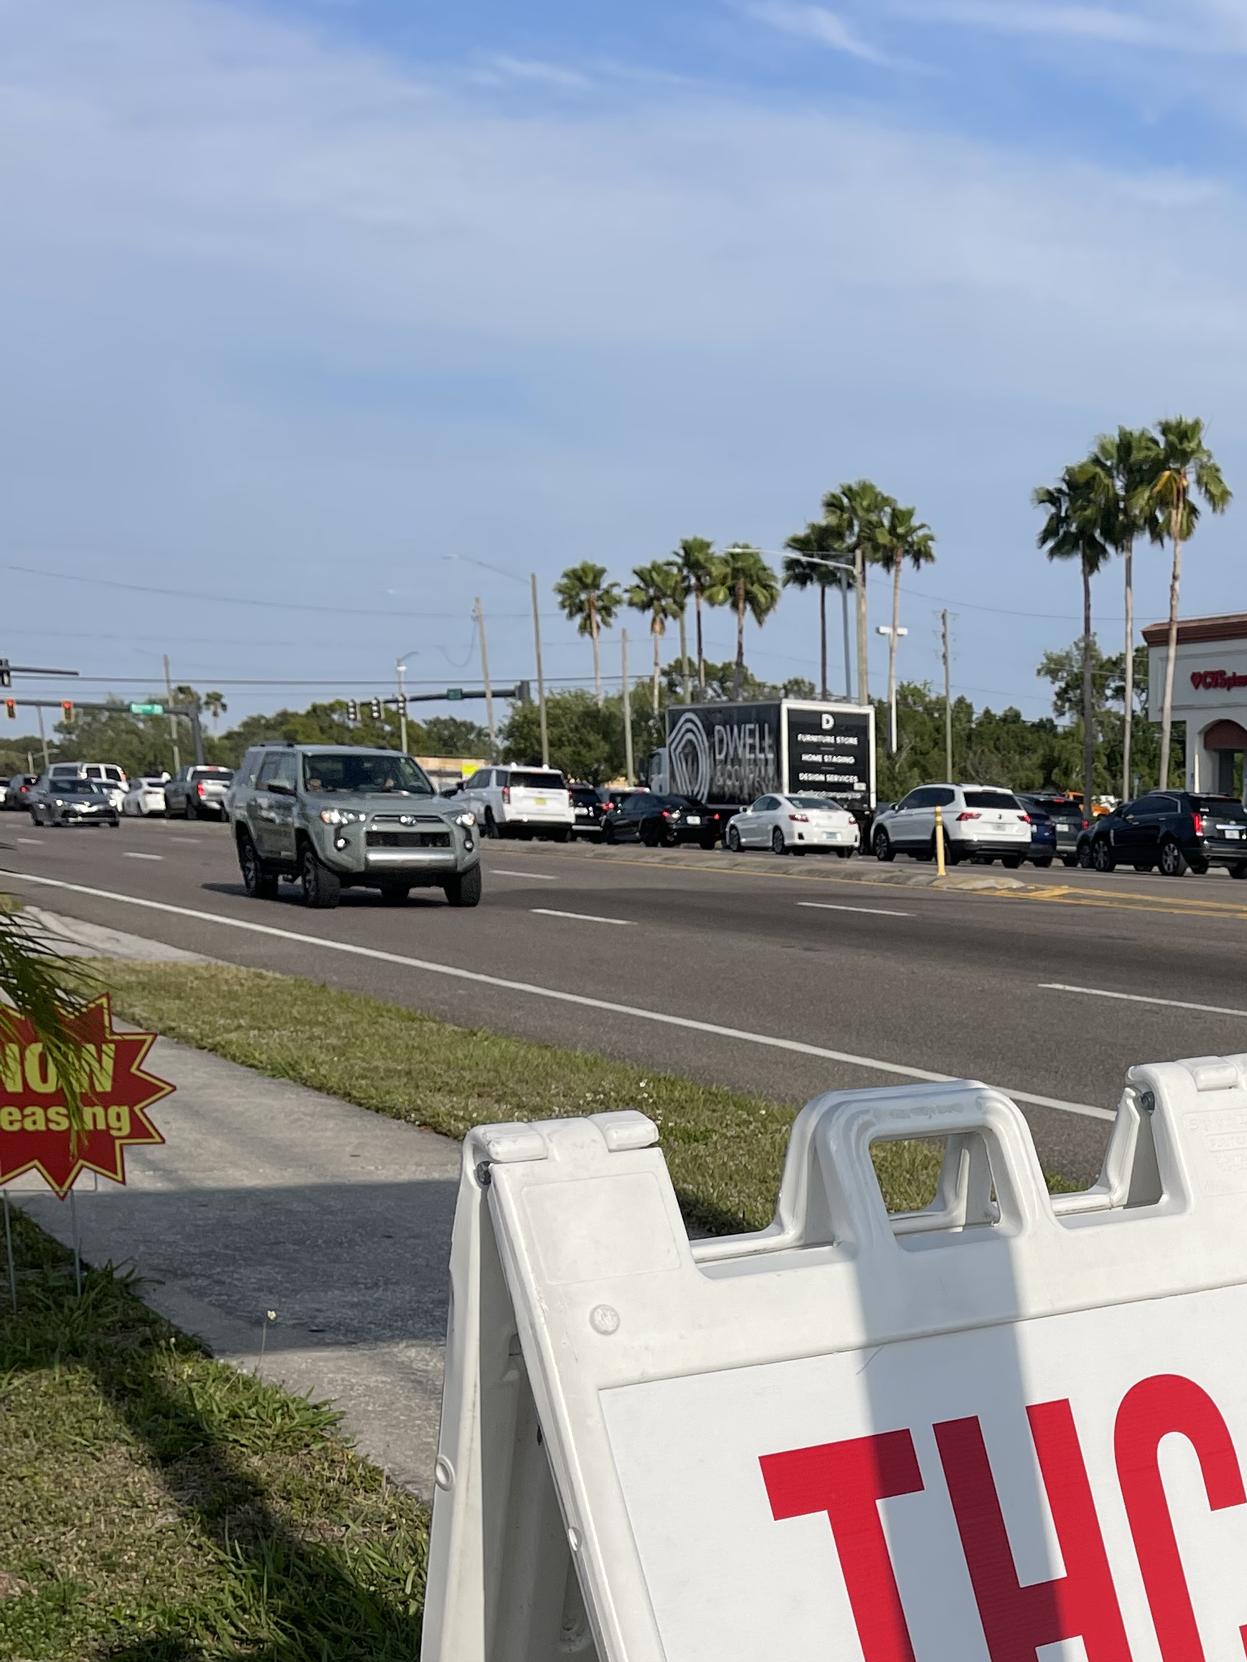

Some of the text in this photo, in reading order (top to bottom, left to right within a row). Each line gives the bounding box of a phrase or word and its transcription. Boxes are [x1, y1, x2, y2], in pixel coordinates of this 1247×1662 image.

[714, 723, 775, 759] DWELL
[797, 733, 858, 746] FURNITURE STORE
[801, 753, 856, 764] HOME STAGING
[798, 772, 859, 783] DESIGN SERVICES
